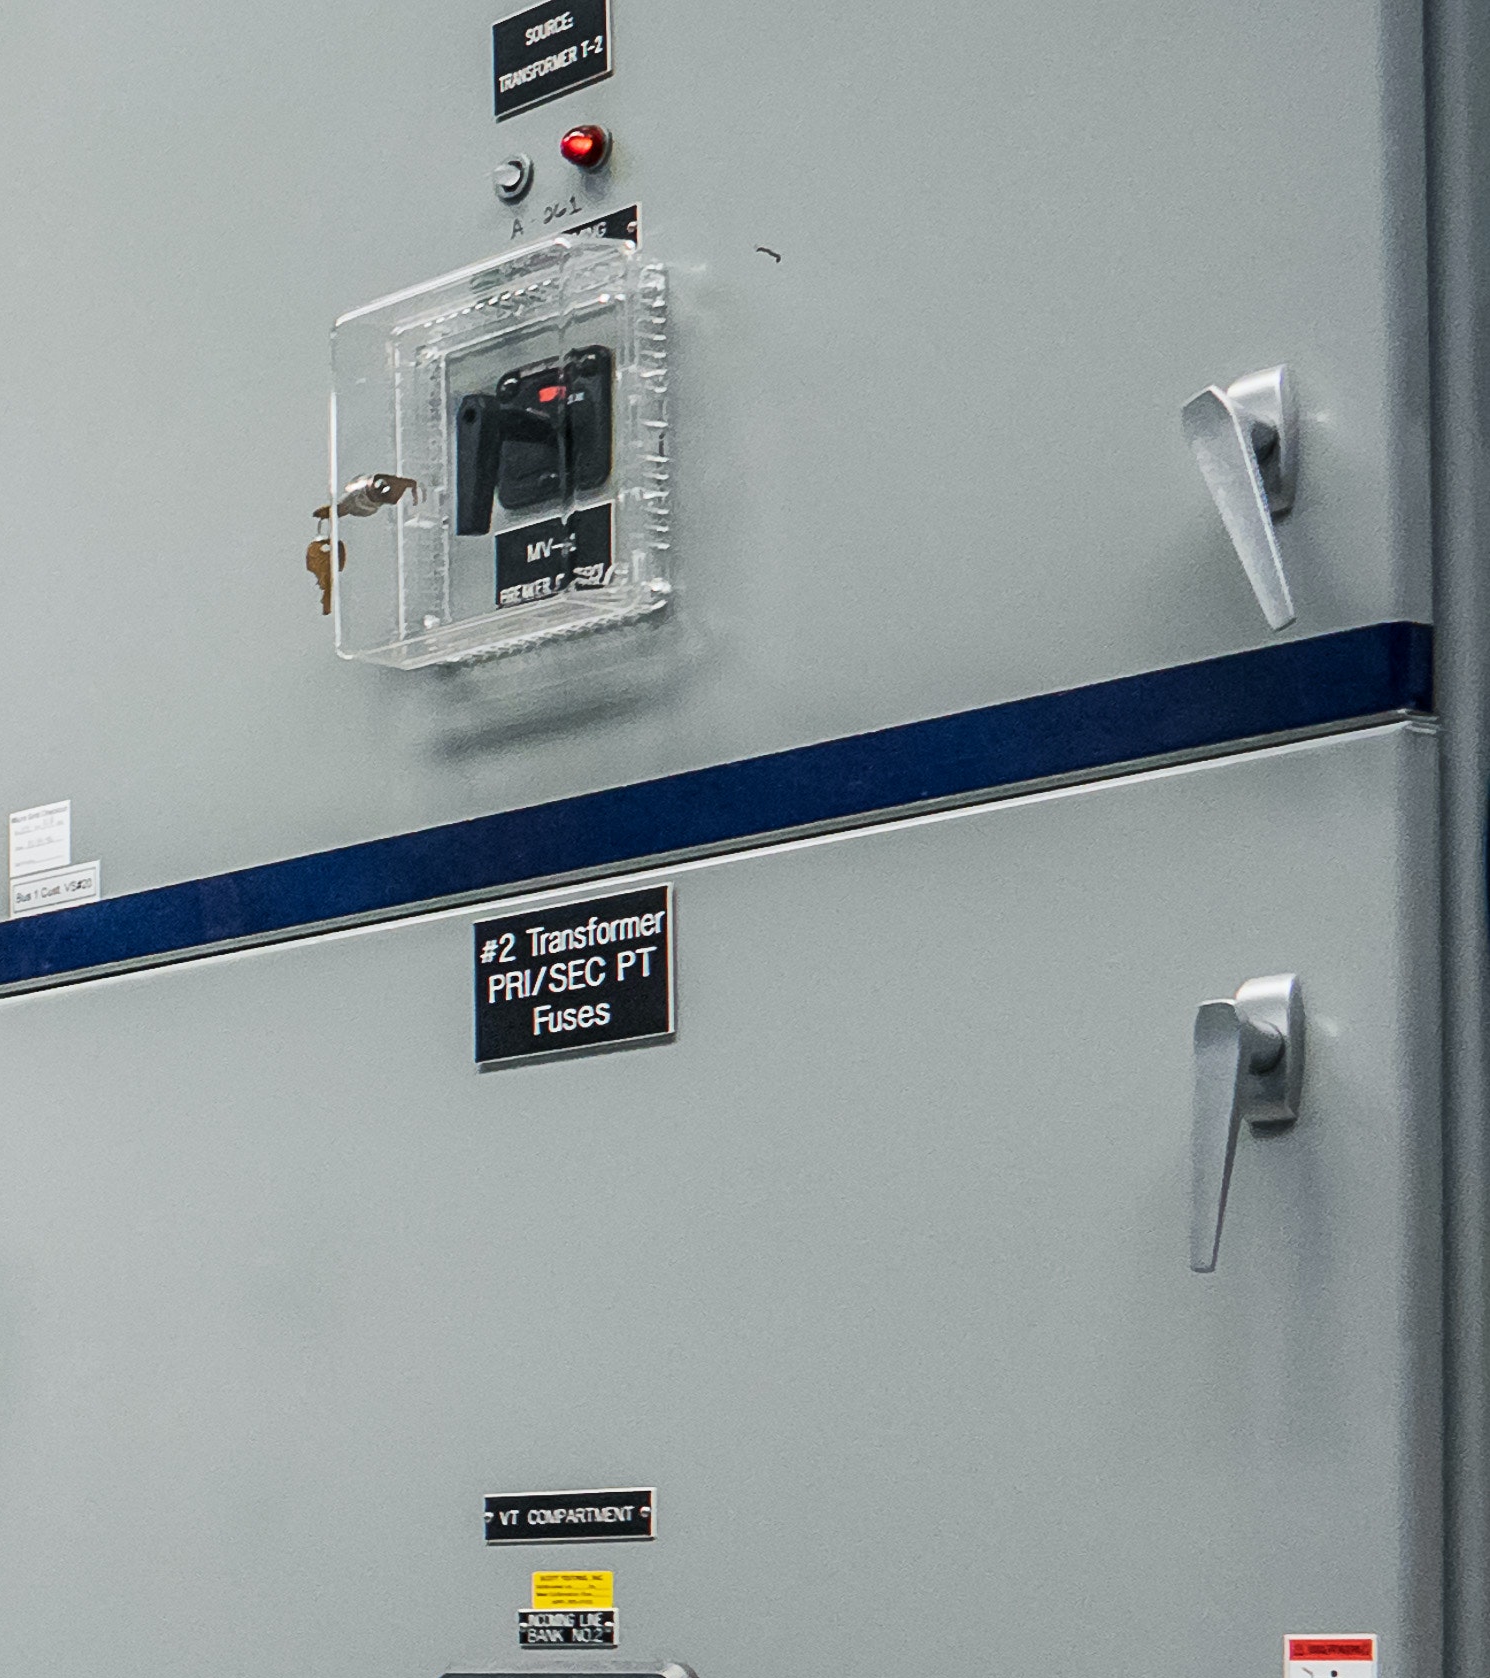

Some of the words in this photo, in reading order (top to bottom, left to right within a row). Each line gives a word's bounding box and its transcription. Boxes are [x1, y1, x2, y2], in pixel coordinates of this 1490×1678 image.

[525, 11, 574, 46] SOURCE:
[498, 46, 578, 93] TRANSFORMER
[580, 35, 604, 59] T-2
[16, 892, 32, 904] Bus
[480, 932, 516, 964] #2
[526, 910, 667, 958] Transformer
[487, 956, 607, 1005] PRI/SEC
[616, 946, 658, 983] PT
[533, 1002, 612, 1036] Fuses
[499, 1509, 520, 1526] VT
[527, 1505, 635, 1525] COMPARTMENT
[527, 1628, 565, 1643] BANK
